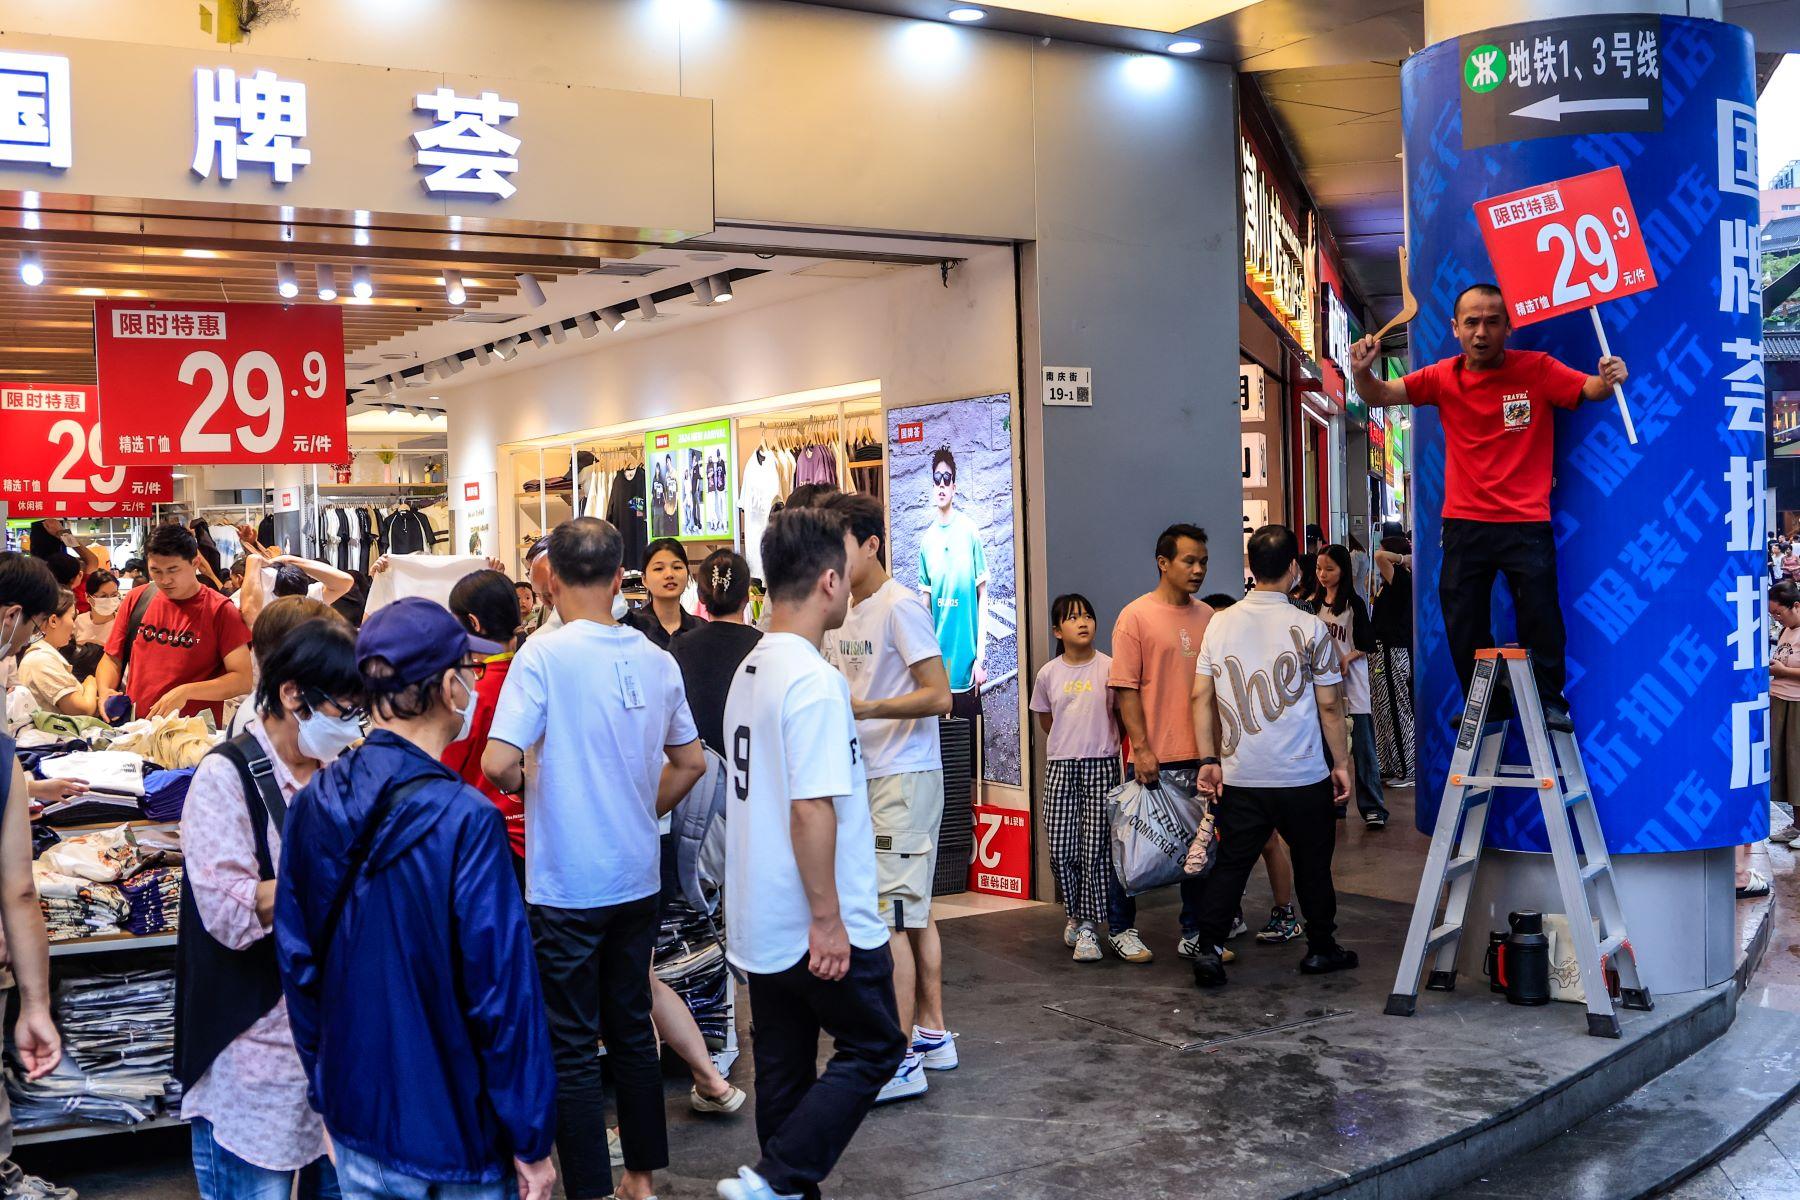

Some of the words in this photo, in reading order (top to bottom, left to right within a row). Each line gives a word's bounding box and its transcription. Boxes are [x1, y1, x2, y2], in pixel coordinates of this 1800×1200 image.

[1508, 31, 1659, 88] 地铁1、3号线
[0, 52, 522, 199] 国牌荟
[1494, 194, 1559, 225] 限时特惠
[1536, 206, 1630, 306] 29.9
[1623, 268, 1646, 286] 元/件
[1515, 295, 1551, 316] 精选T恤
[119, 312, 220, 336] 限时特惠
[7, 391, 81, 409] 限时特惠
[177, 350, 327, 453] 29.9
[1049, 387, 1074, 400] 19-1
[1502, 393, 1527, 401] TRAVEL
[119, 435, 171, 453] 精选T恤
[293, 435, 332, 453] 元/件
[3, 479, 41, 492] 精选T恤
[132, 482, 161, 495] 元/件
[18, 501, 43, 511] 休闲裤
[121, 501, 146, 511] 元/件
[1572, 468, 1720, 645] 服装行
[168, 635, 200, 643] GREAT
[1582, 624, 1718, 798] 折扣店
[733, 725, 750, 801] 9
[1129, 815, 1178, 858] COMMERCE
[981, 875, 1019, 891] 限时特惠
